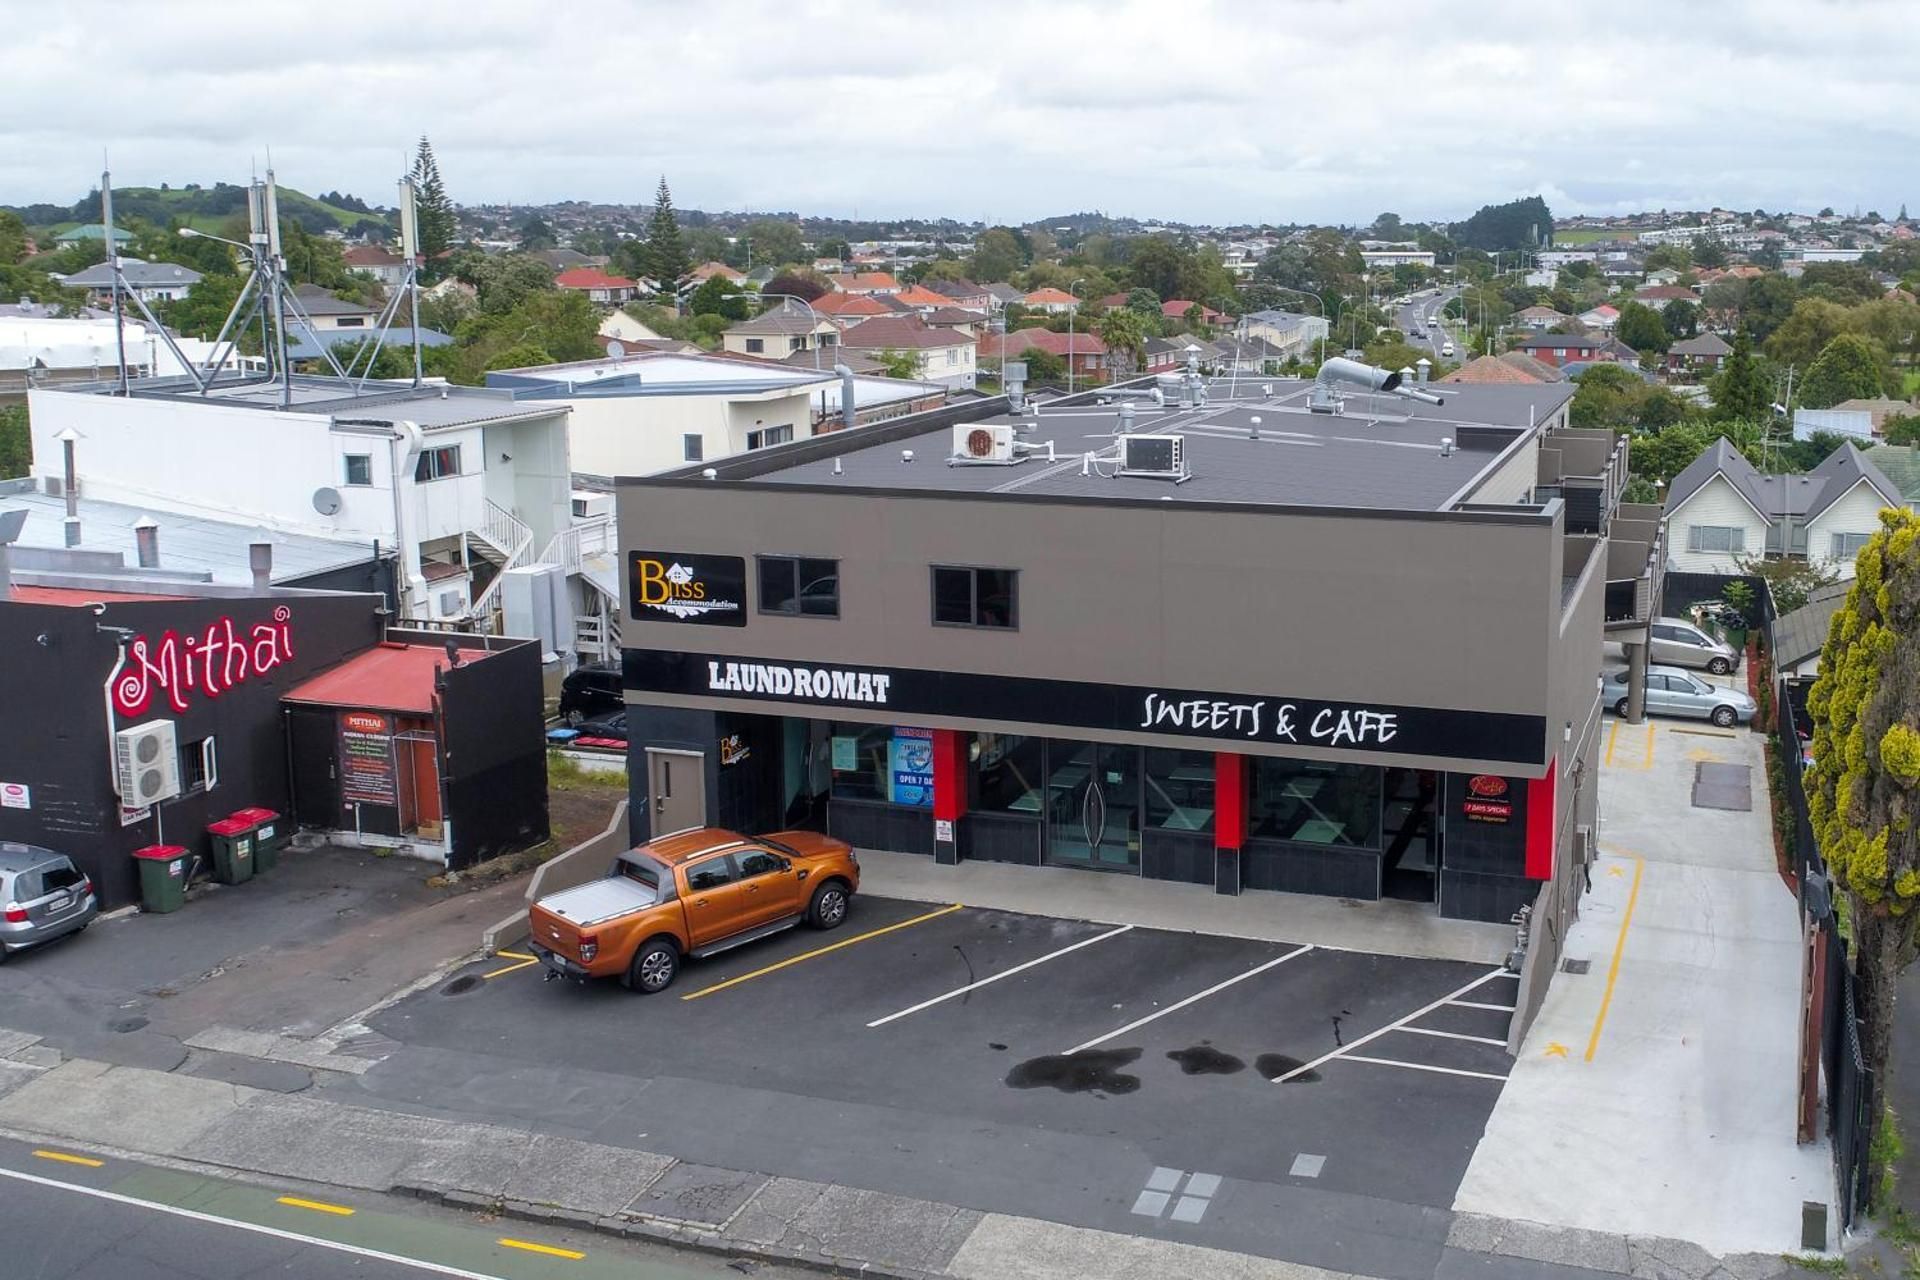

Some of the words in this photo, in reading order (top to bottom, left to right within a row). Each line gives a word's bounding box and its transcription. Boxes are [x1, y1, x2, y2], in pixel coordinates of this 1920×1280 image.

[637, 559, 705, 605] Bliss
[666, 597, 739, 610] Accommodation
[117, 604, 294, 708] Mithai
[708, 661, 890, 703] LAUNDROMAT
[349, 717, 381, 727] MITHAI
[1140, 693, 1265, 736] SWEETS
[1276, 704, 1298, 743] &
[1310, 708, 1398, 746] CAFE
[900, 775, 917, 784] OPEN
[918, 776, 923, 785] 7
